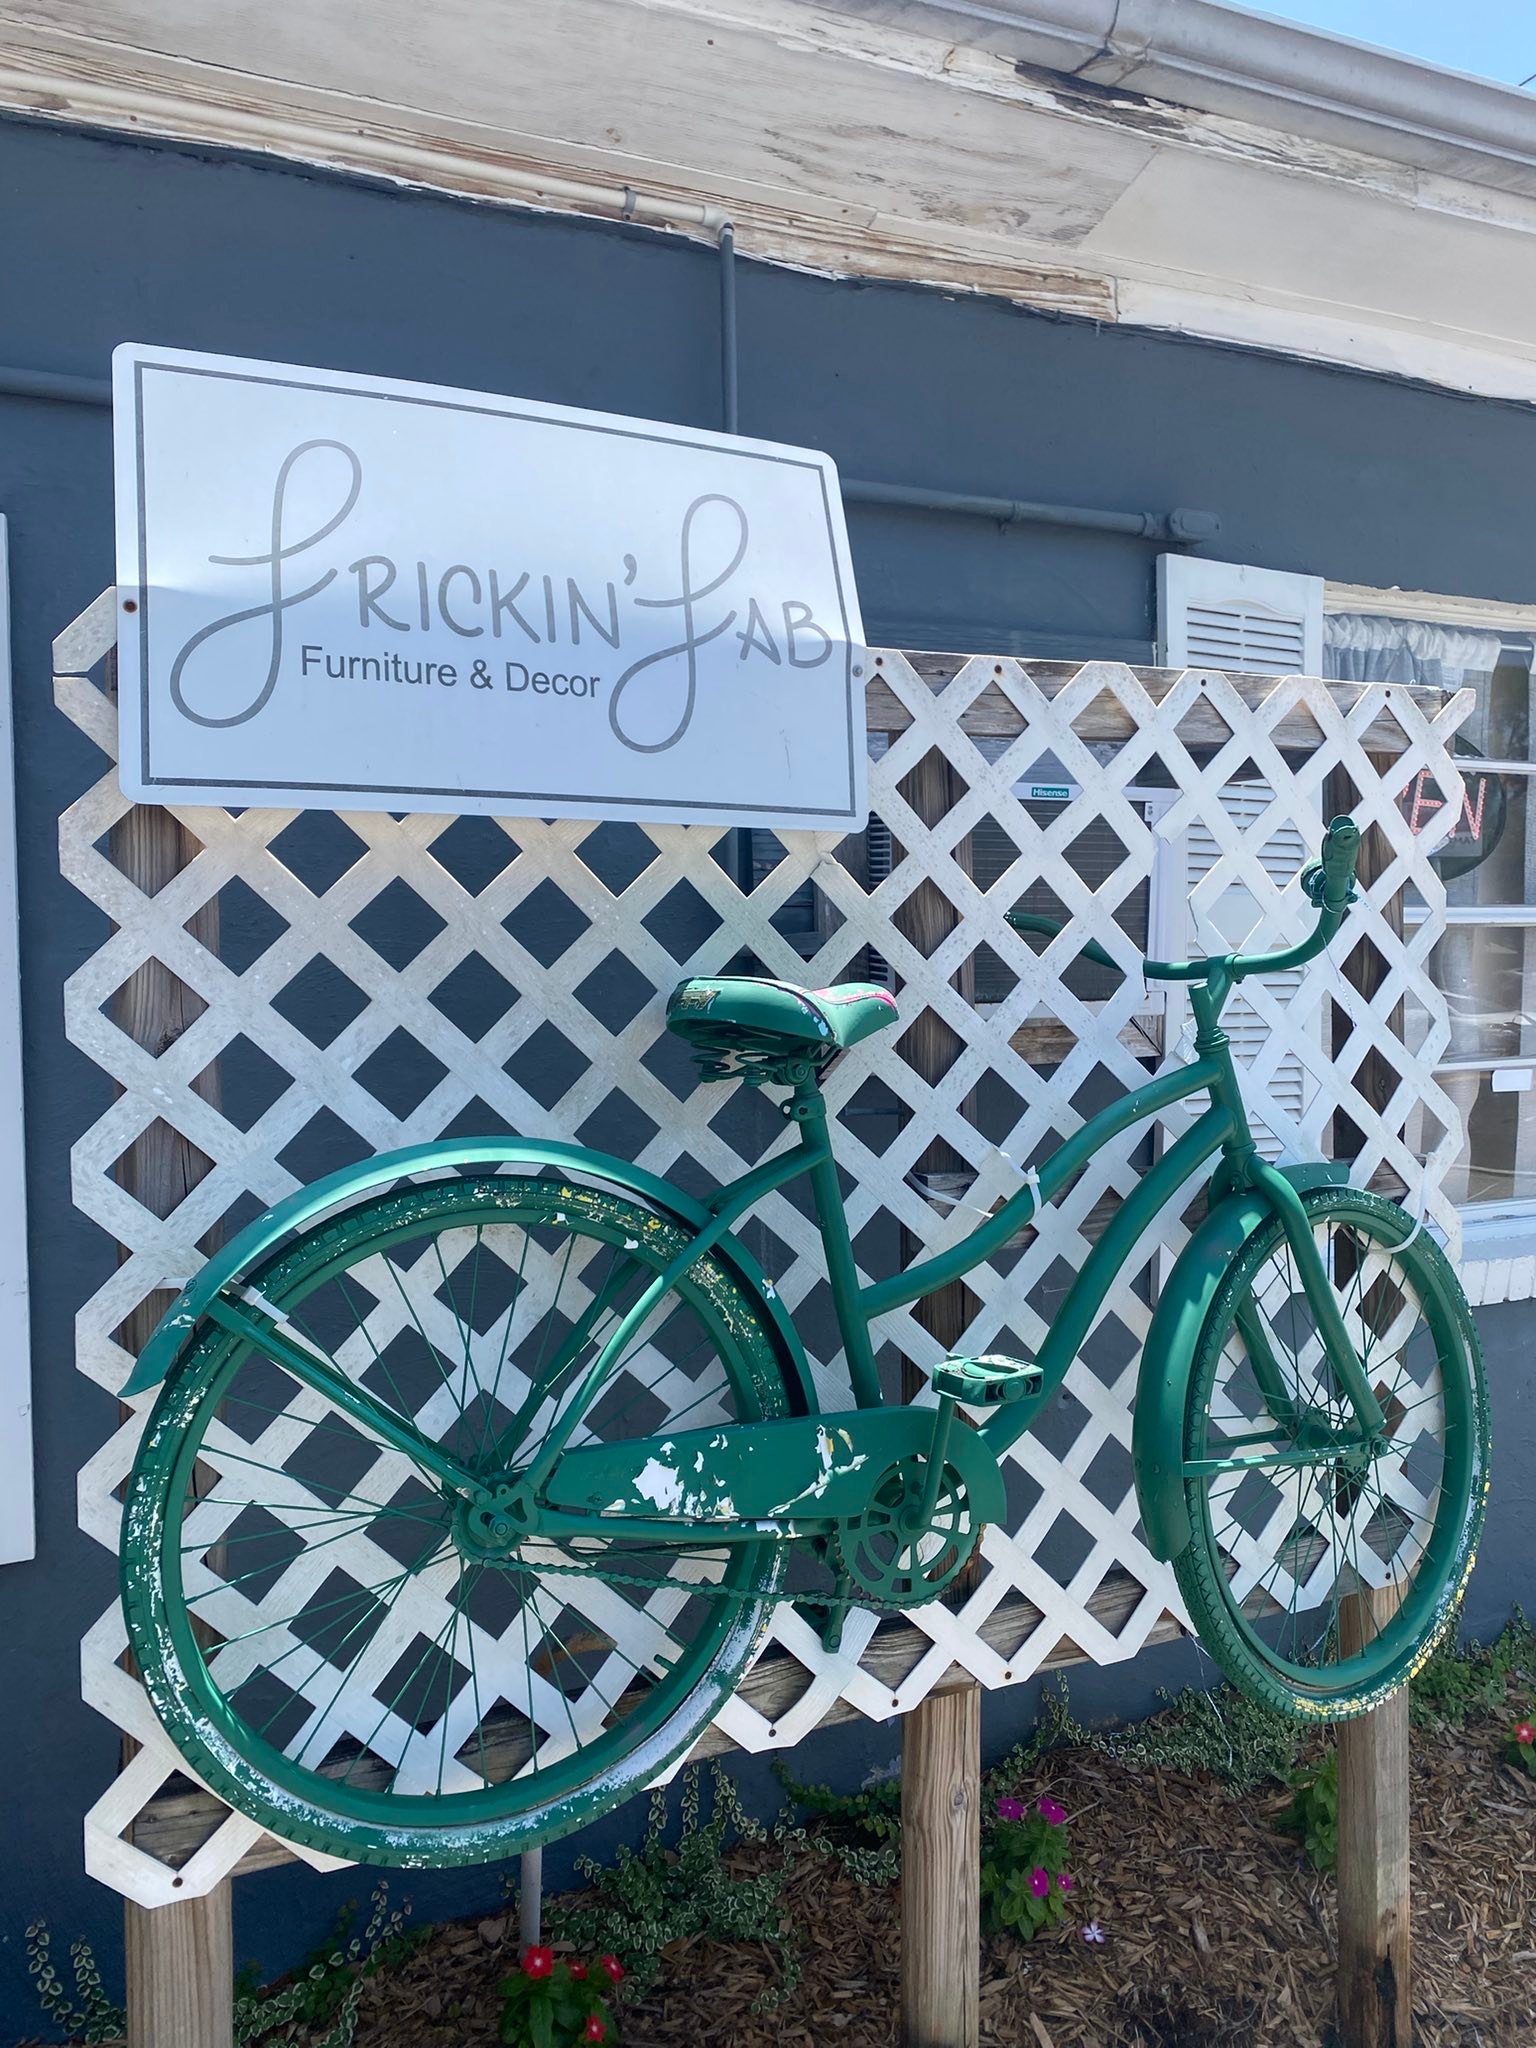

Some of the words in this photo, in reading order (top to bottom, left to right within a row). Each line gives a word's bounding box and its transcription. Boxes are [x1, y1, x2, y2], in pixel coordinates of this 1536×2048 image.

[608, 493, 833, 754] FAB
[301, 645, 458, 687] Furniture
[469, 658, 494, 690] &
[505, 661, 600, 698] Decor
[1032, 787, 1068, 797] Hisense
[1402, 768, 1487, 840] EN
